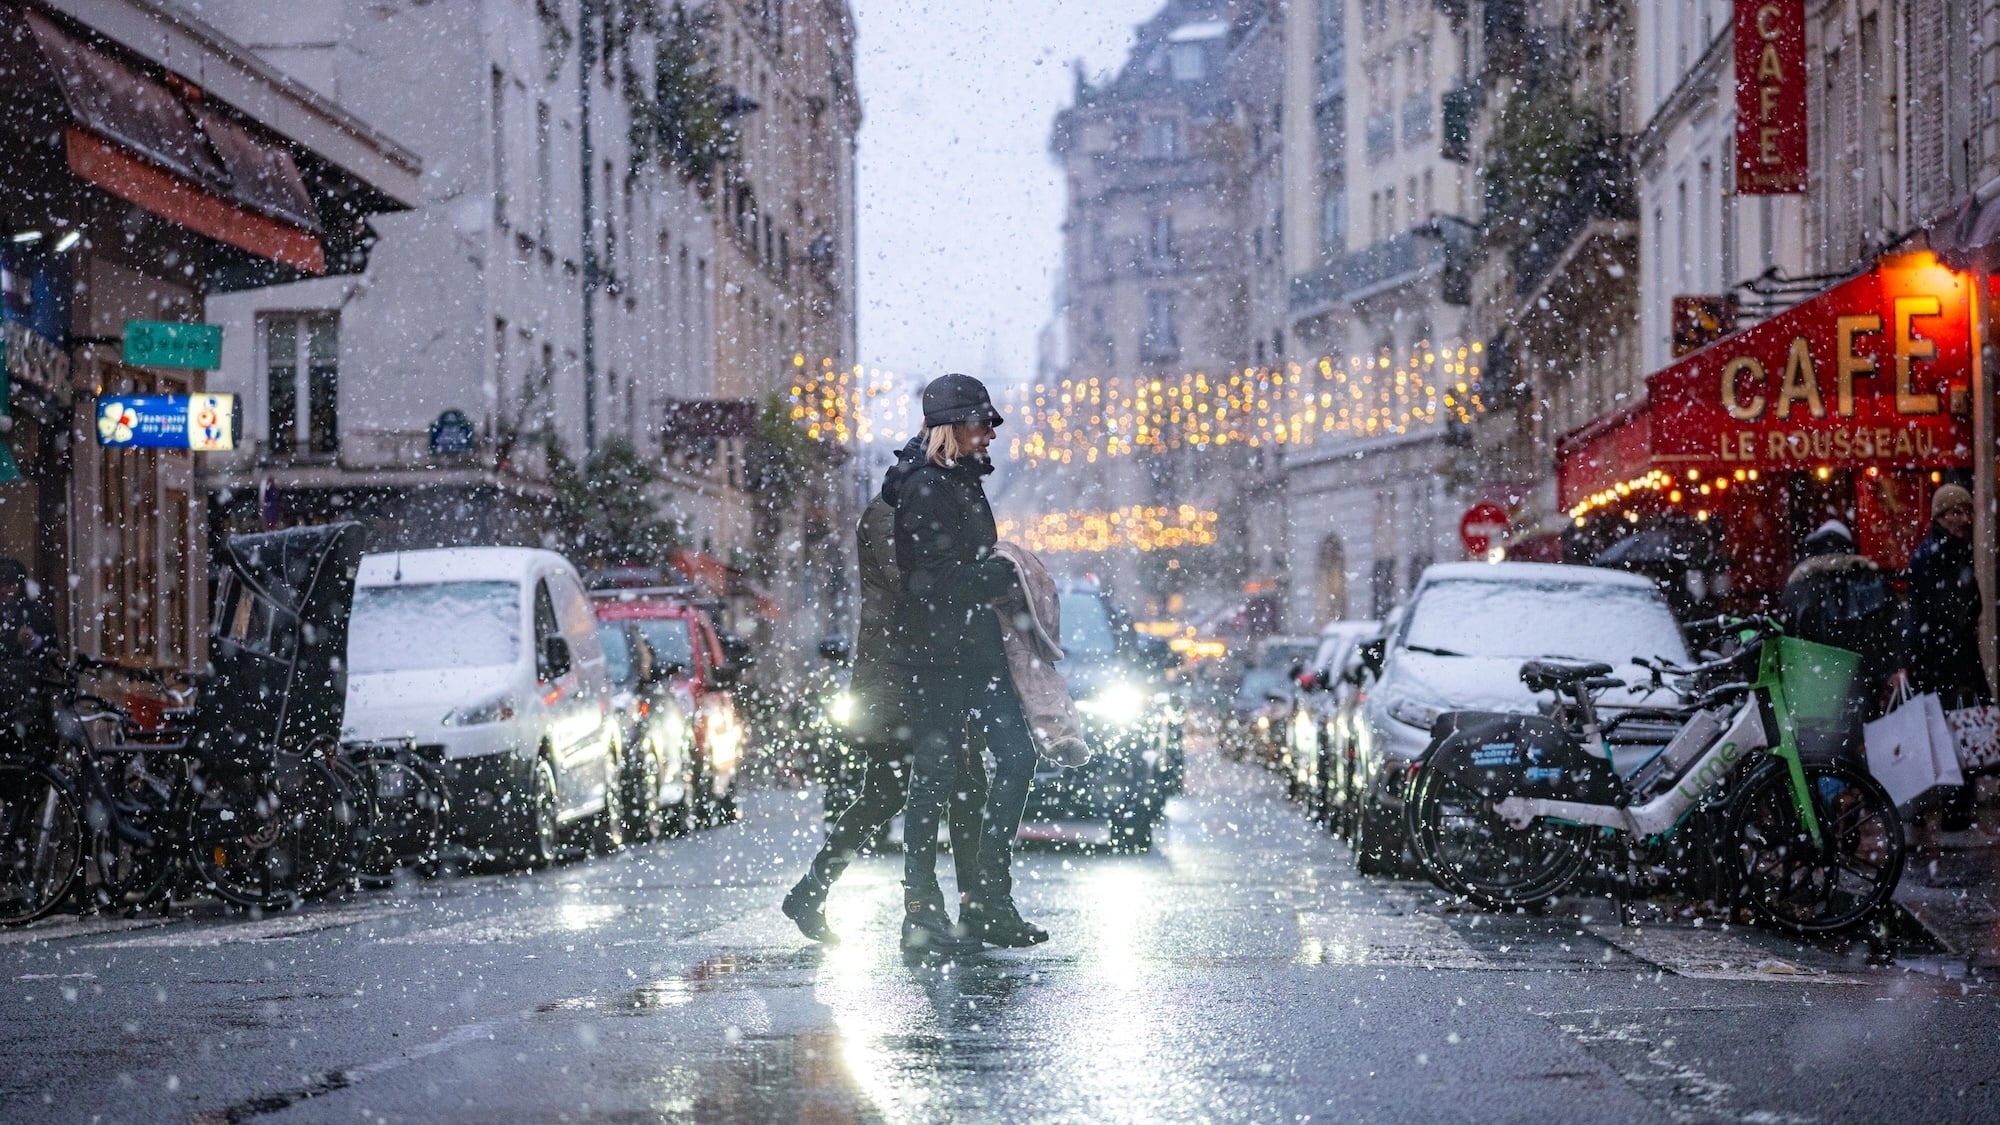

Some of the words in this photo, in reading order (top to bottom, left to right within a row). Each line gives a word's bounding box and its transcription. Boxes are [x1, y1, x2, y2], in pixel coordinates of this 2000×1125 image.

[1757, 5, 1783, 165] CAFE
[1721, 296, 1940, 419] CAFE
[1721, 431, 1755, 461] LE
[1769, 427, 1933, 459] ROUSSEAU
